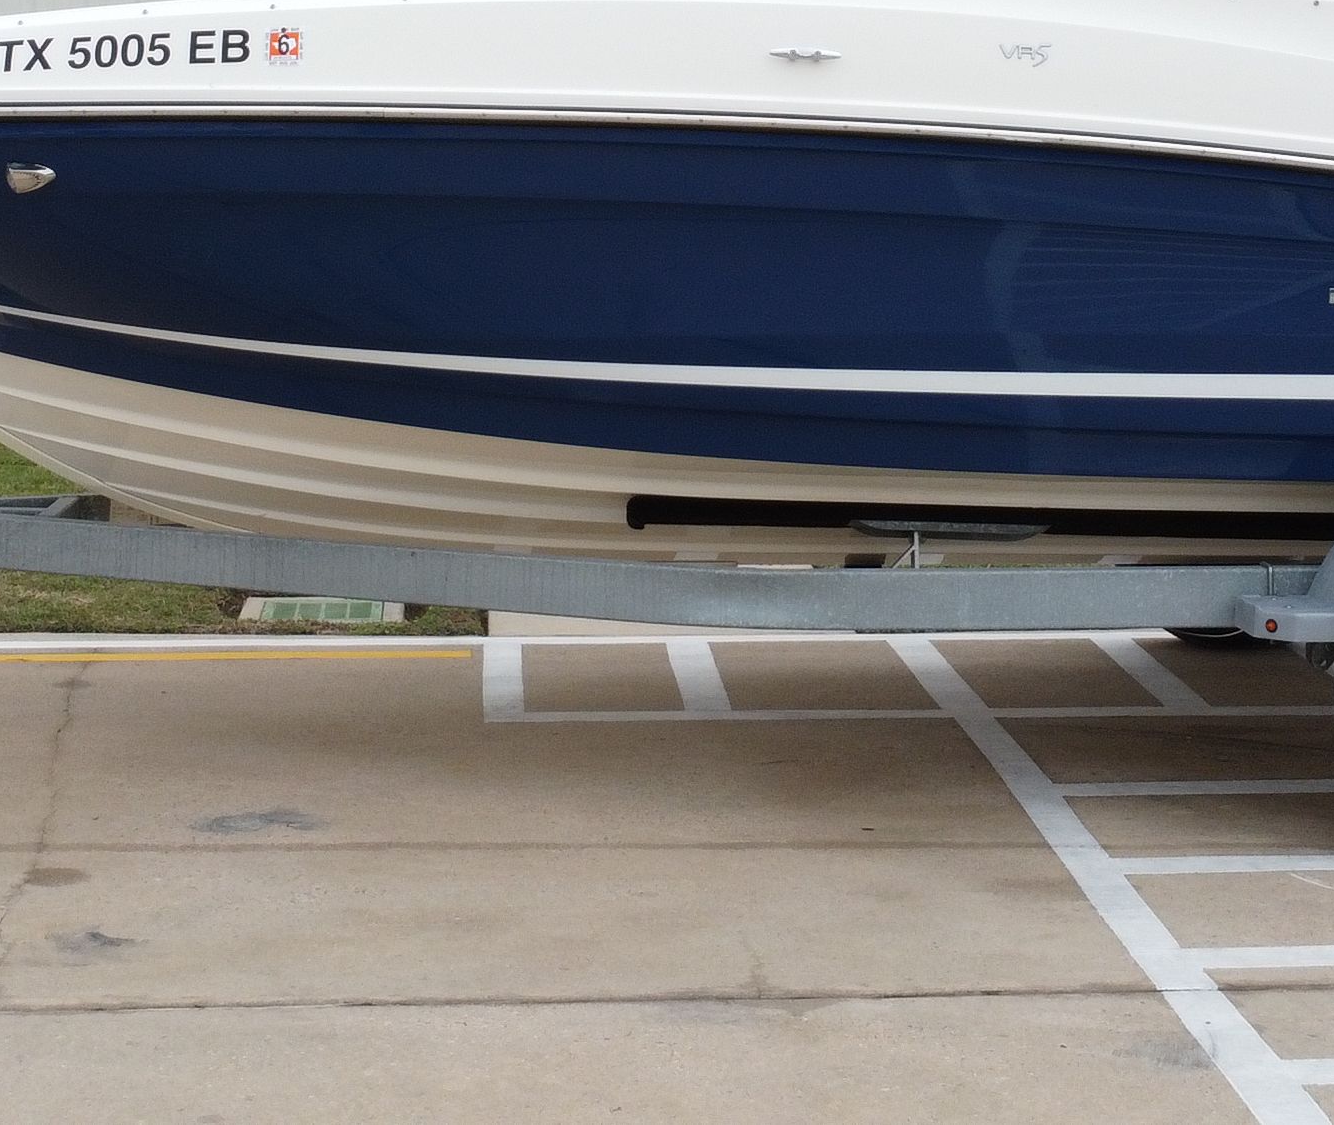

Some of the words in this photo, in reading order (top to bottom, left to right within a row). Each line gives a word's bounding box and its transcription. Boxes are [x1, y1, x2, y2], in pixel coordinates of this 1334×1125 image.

[67, 33, 171, 69] 5005
[189, 29, 250, 64] EB
[277, 33, 290, 56] 6
